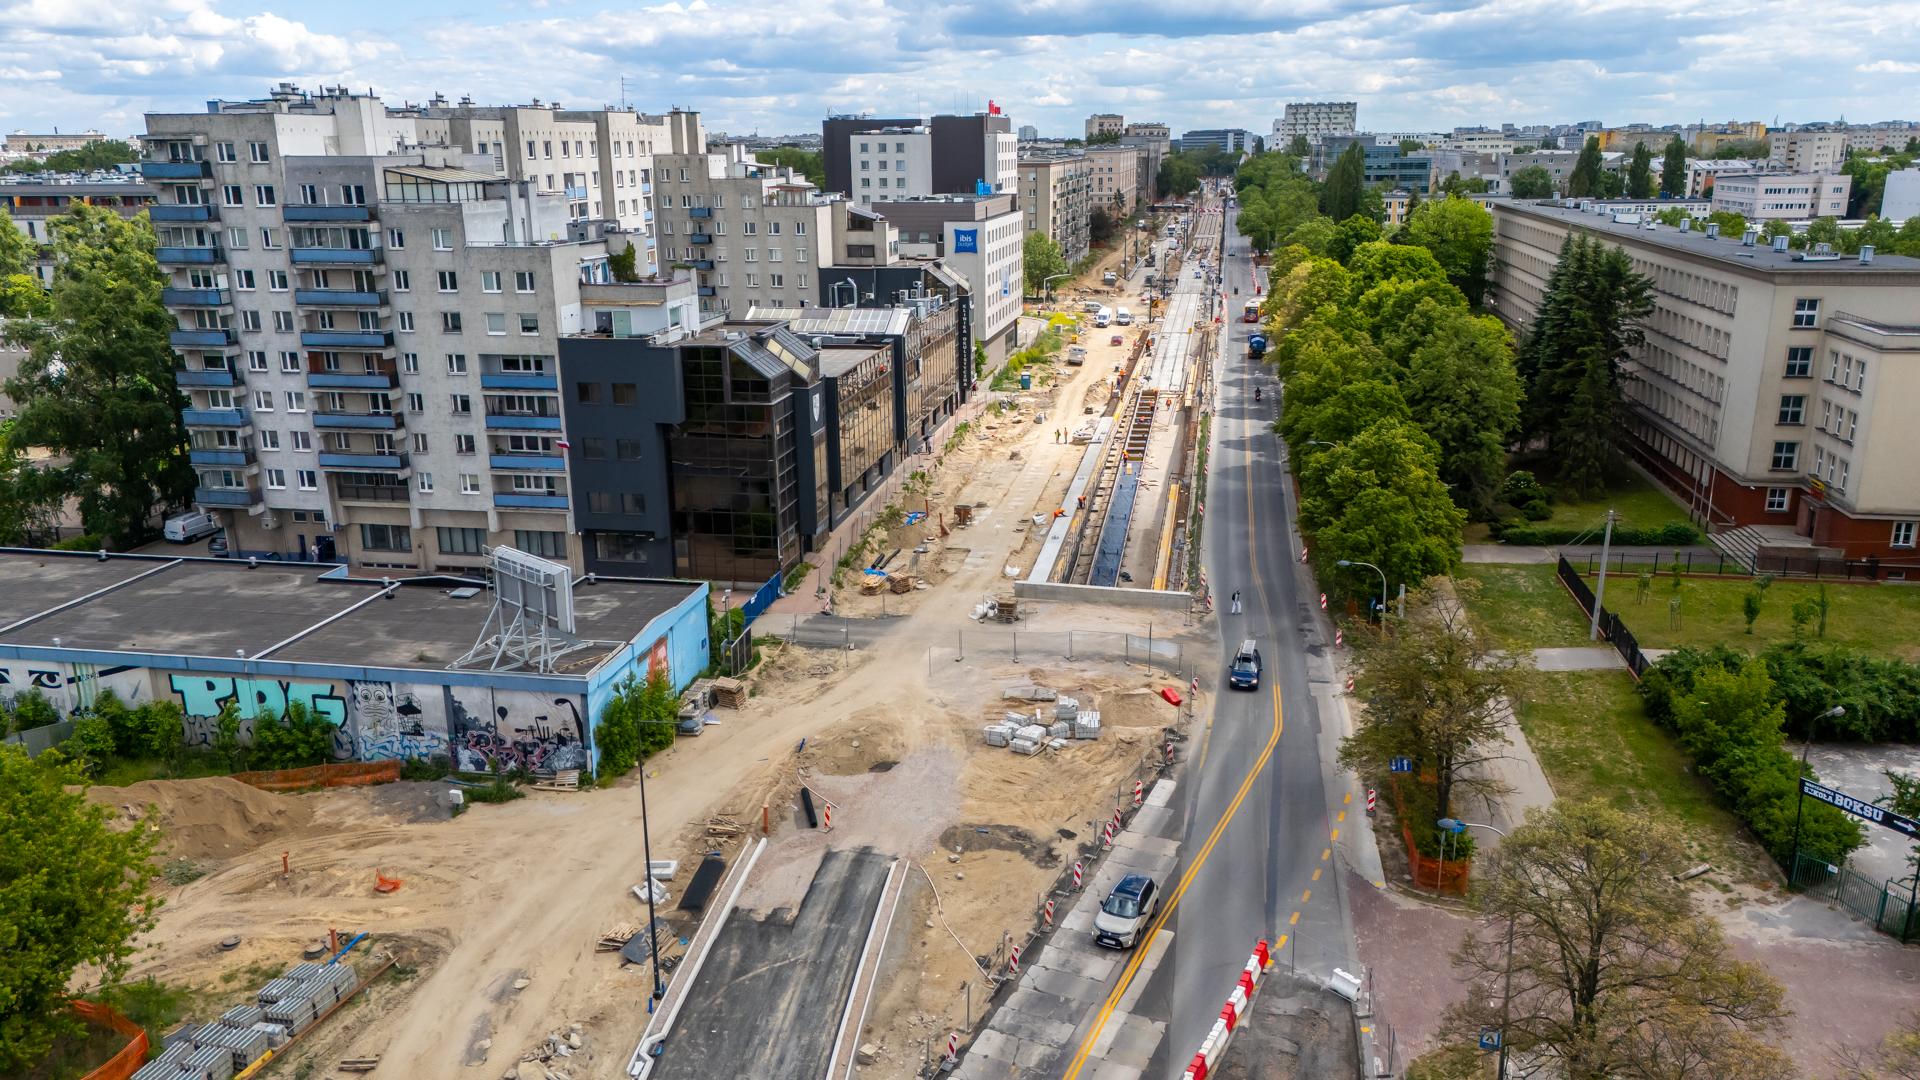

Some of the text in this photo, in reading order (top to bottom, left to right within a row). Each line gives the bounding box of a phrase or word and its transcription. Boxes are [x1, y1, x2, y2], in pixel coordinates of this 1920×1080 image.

[960, 234, 972, 242] ibis
[1804, 786, 1884, 822] SZKOŁA BOKSU
